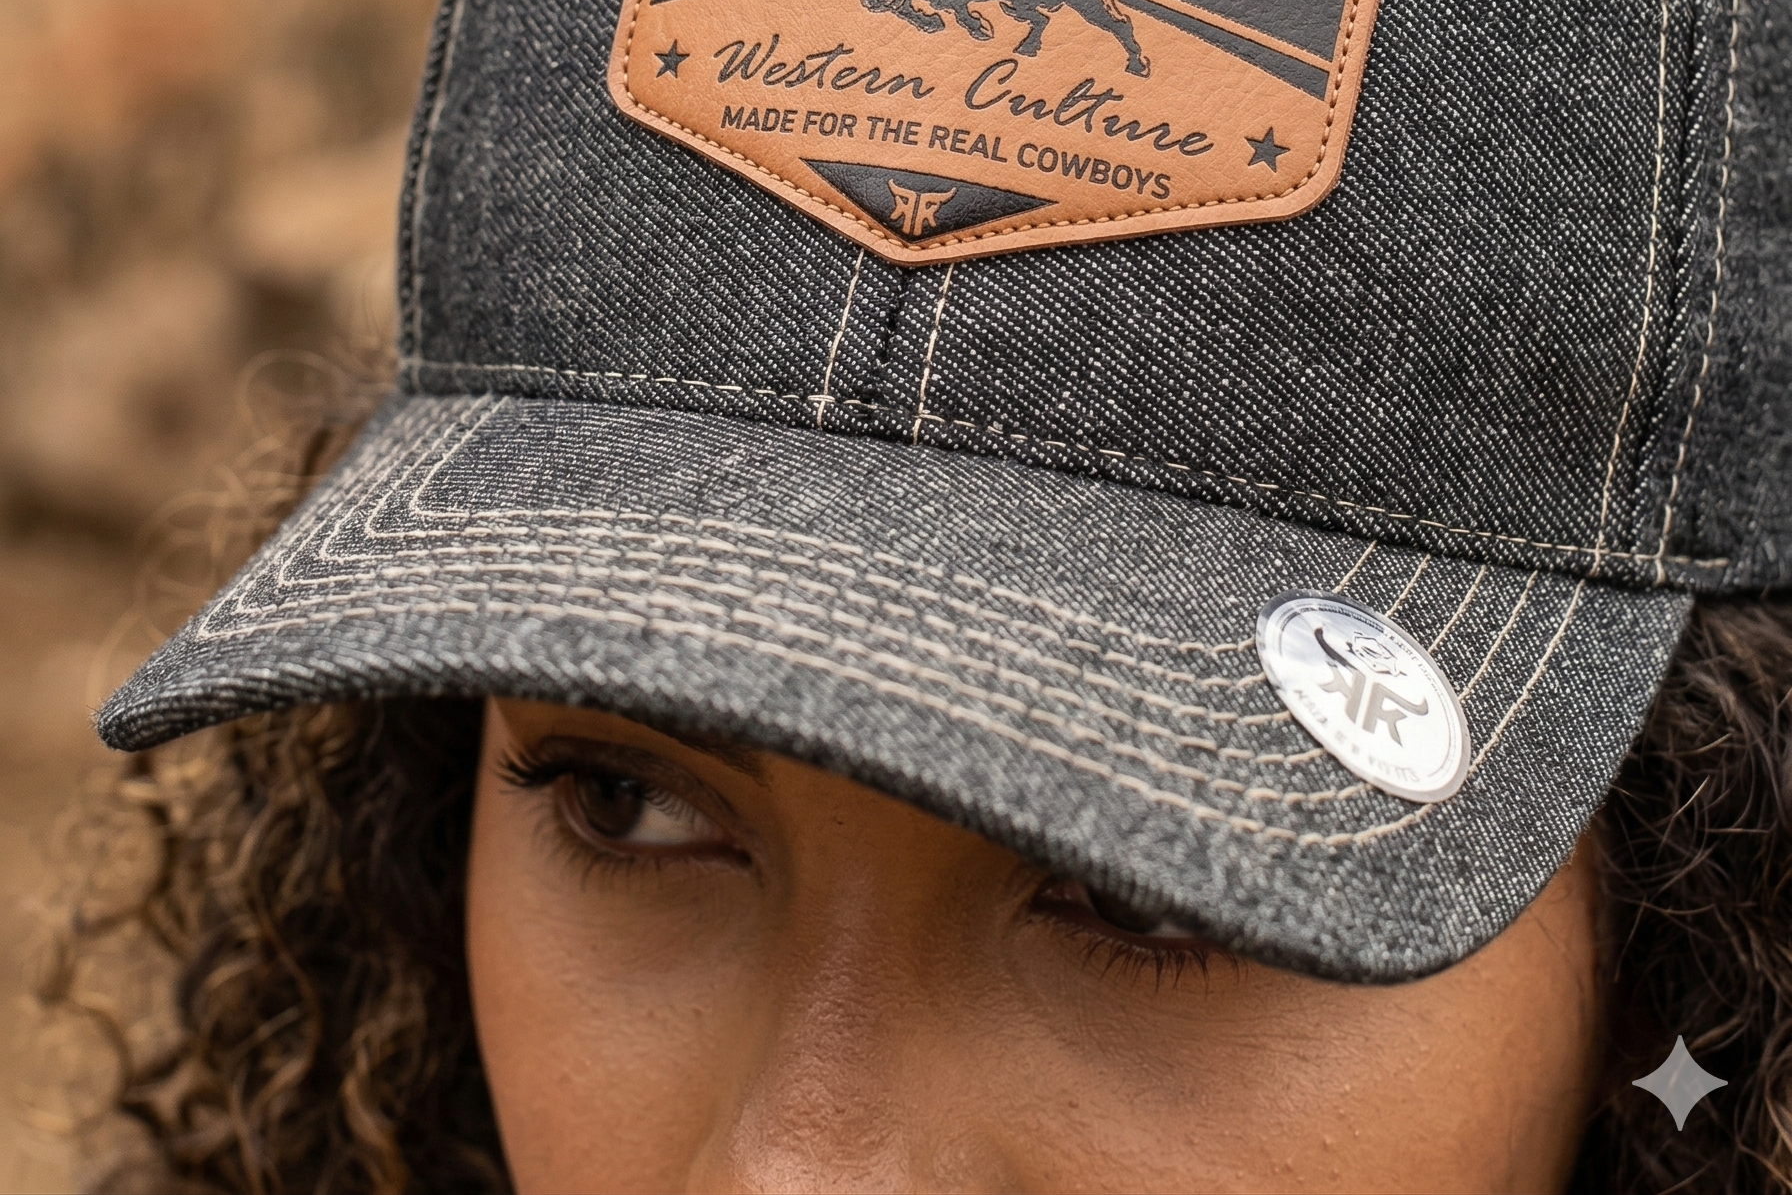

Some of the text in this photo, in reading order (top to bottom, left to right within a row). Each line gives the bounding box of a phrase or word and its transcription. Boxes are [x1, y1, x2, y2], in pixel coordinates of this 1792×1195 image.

[713, 33, 1215, 157] Western Culture
[720, 105, 1172, 201] MADE FOR THE REAL COWBOYS
